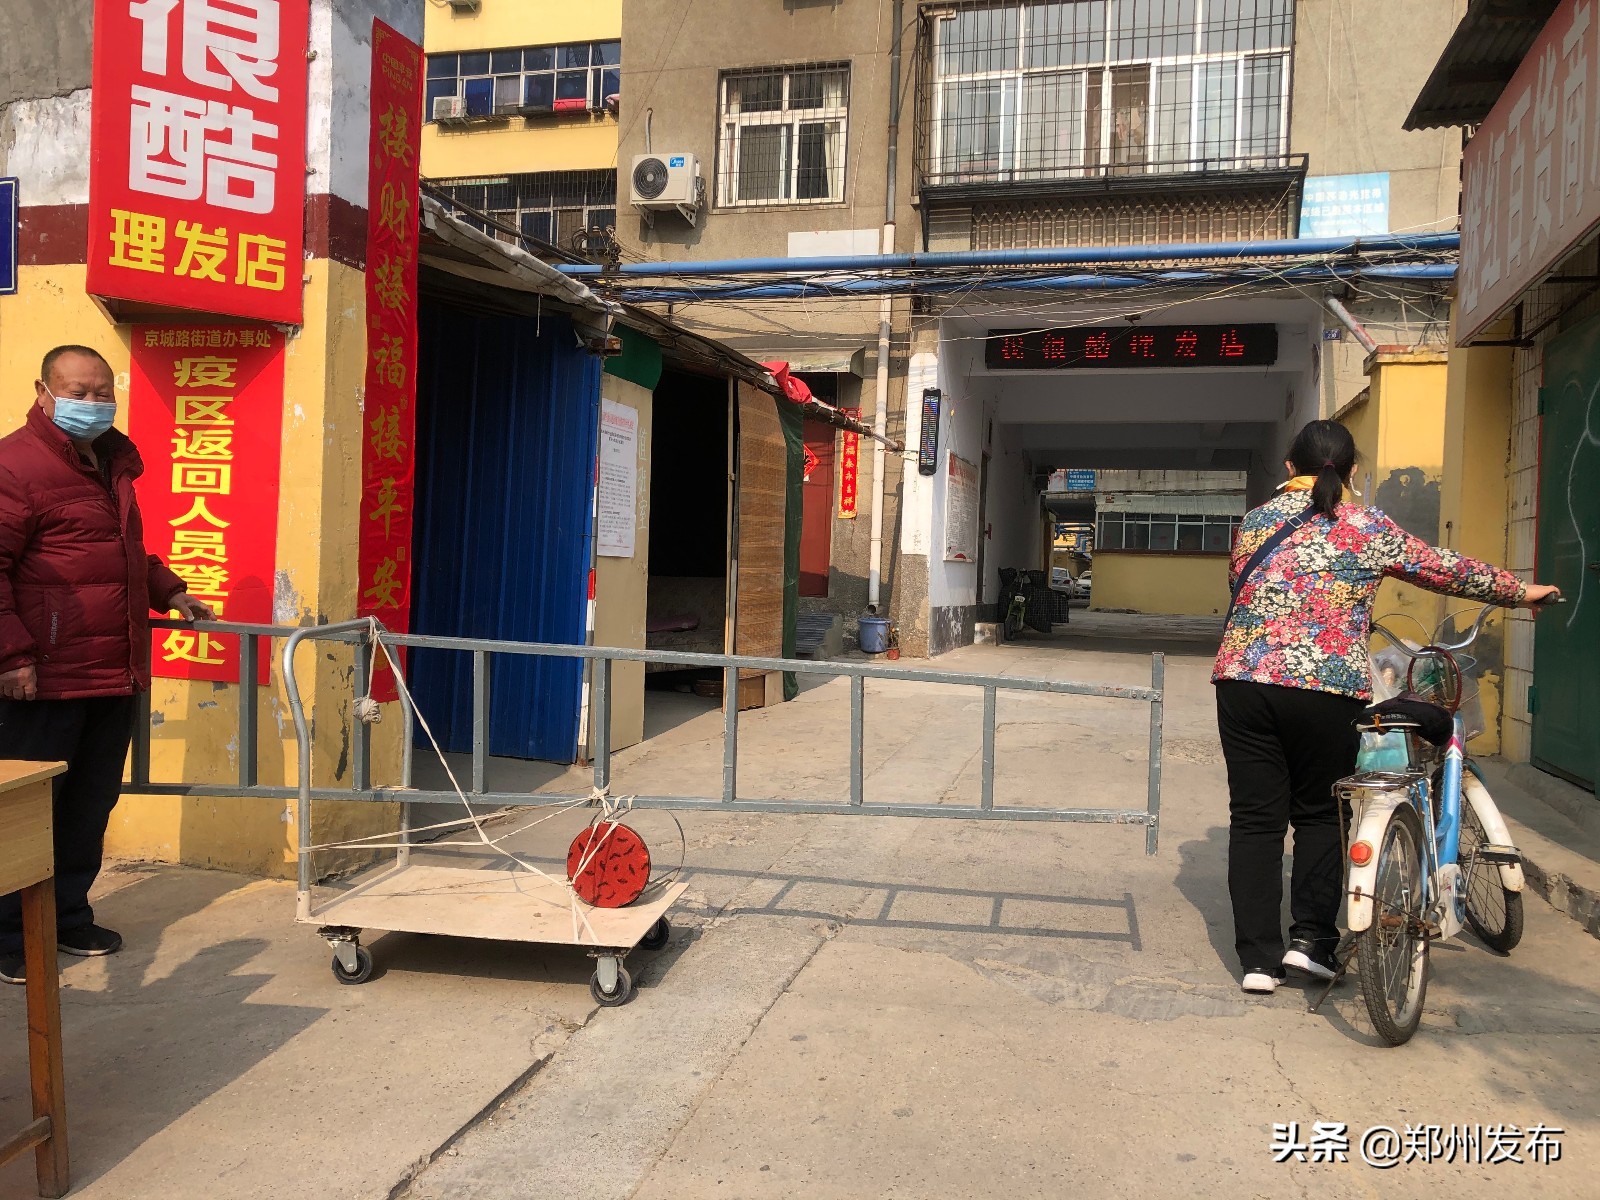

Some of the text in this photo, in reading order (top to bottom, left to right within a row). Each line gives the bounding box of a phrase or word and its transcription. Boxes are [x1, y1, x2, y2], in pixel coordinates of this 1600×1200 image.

[129, 0, 279, 215] 很酷
[1459, 0, 1600, 314] 继红百货商
[108, 208, 286, 291] 理发店
[144, 329, 271, 348] 京城路街道办事处
